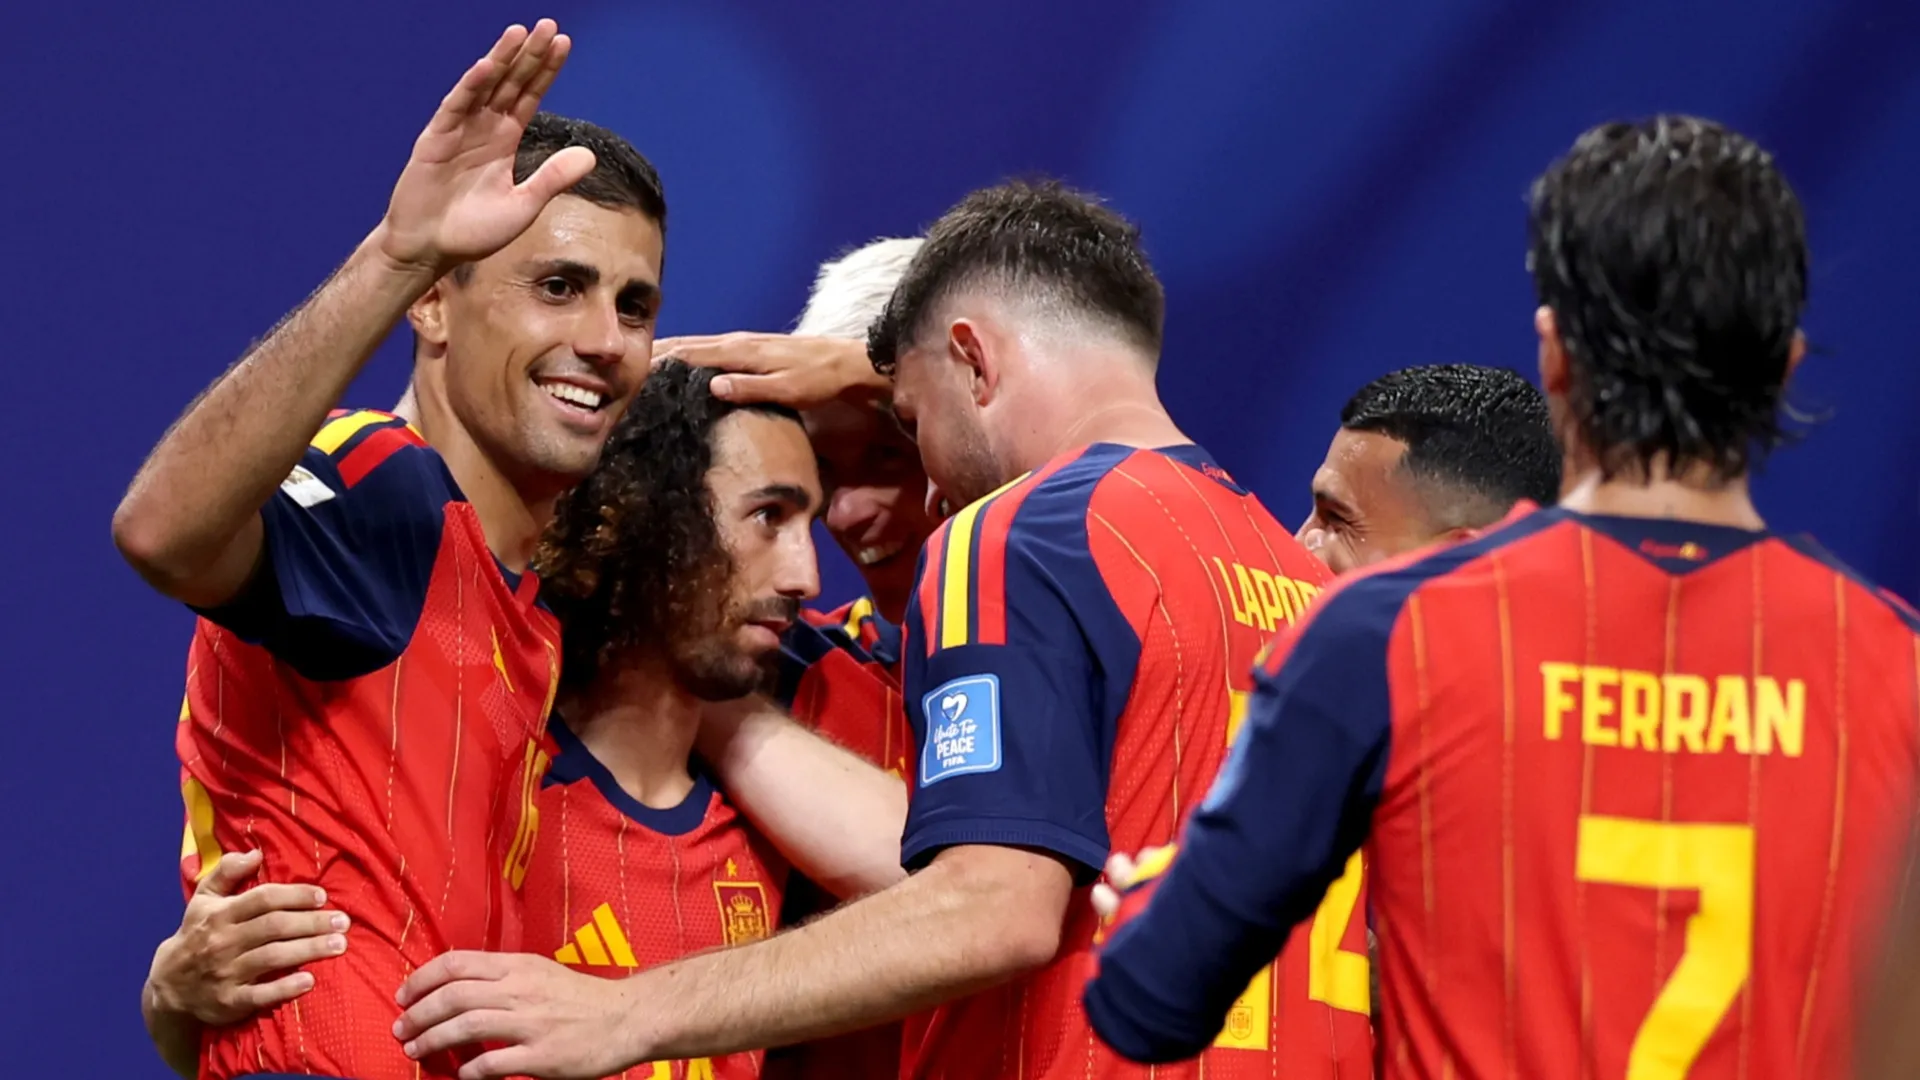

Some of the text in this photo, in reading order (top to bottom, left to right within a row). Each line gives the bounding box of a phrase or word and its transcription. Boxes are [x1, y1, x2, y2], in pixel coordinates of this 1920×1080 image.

[1540, 661, 1805, 757] FERRAN
[934, 718, 978, 744] Unite For
[937, 736, 975, 760] PEACE
[943, 755, 966, 768] FIFA
[1575, 815, 1757, 1080] 7
